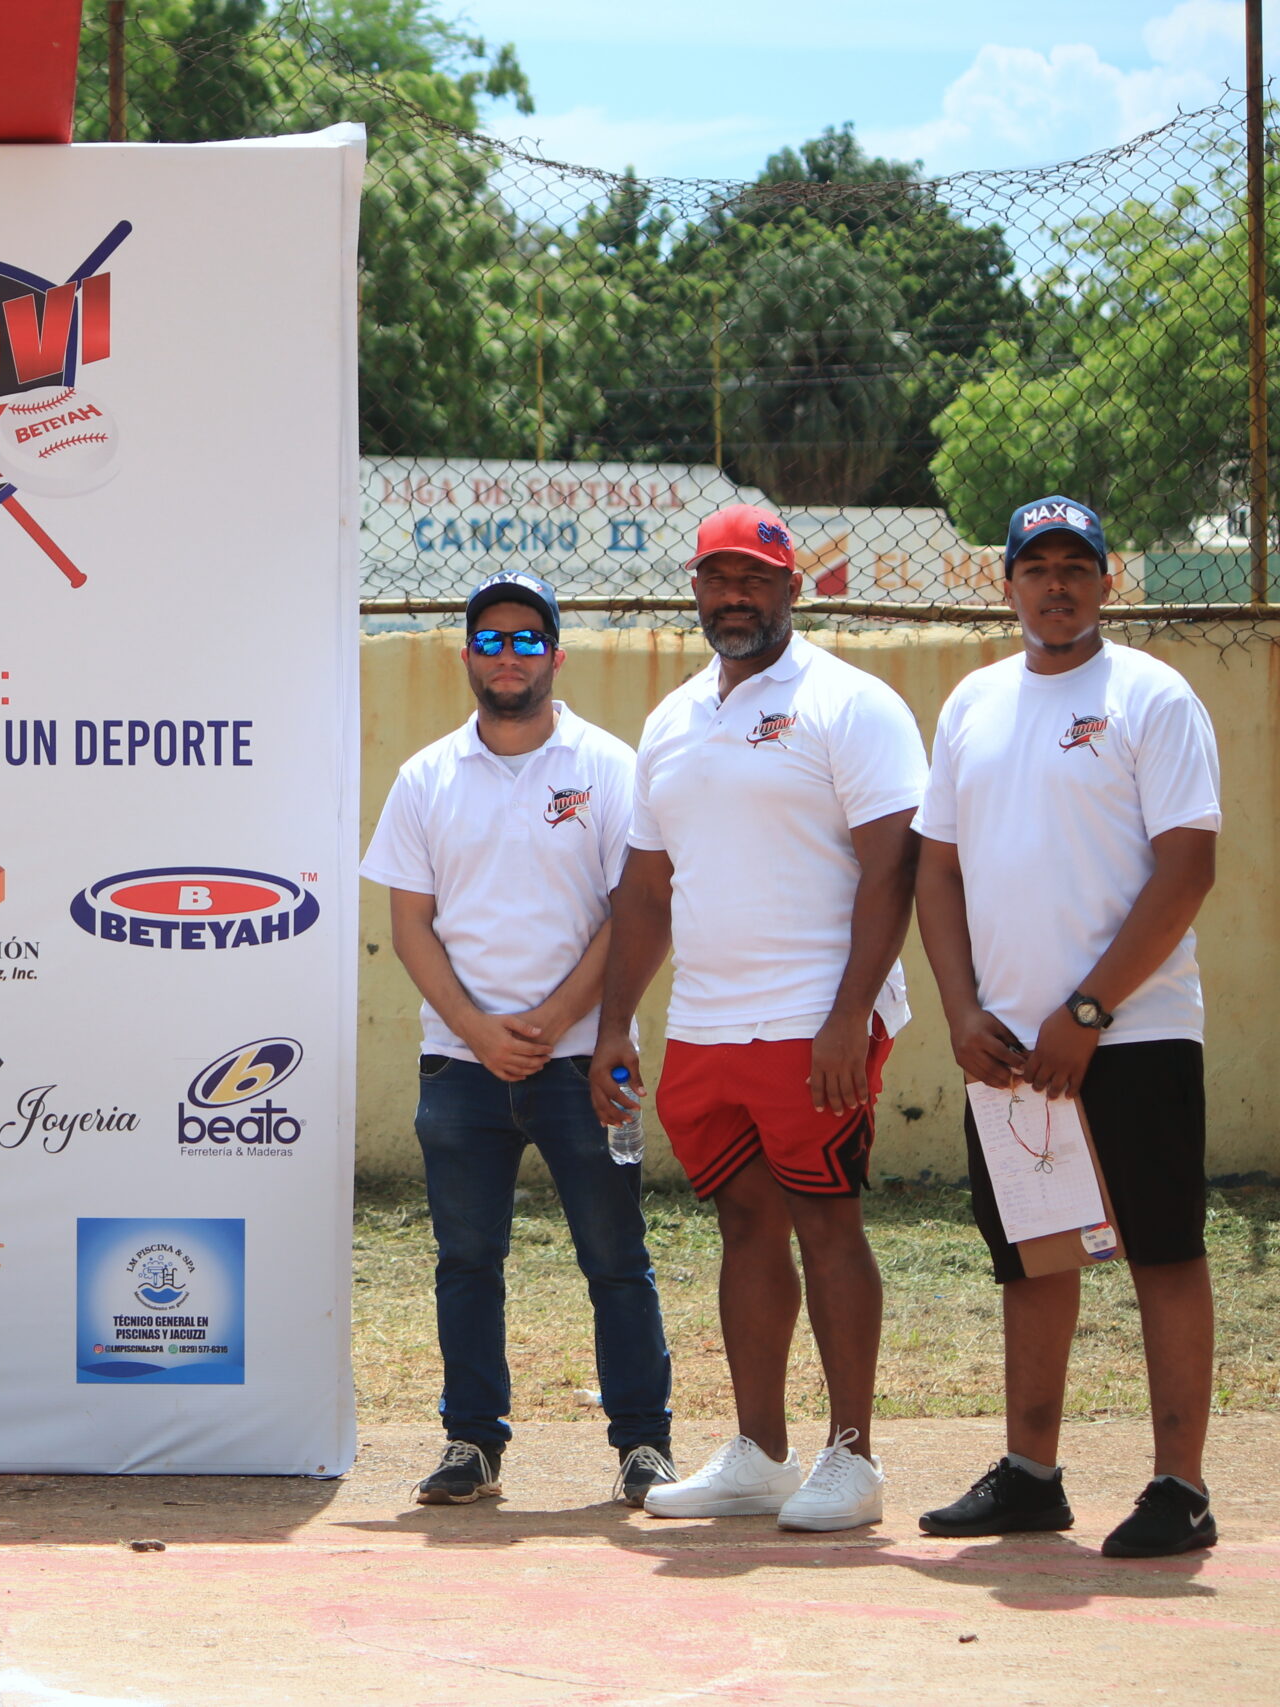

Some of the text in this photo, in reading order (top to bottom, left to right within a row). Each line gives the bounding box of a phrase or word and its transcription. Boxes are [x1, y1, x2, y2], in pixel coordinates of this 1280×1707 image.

[14, 403, 103, 445] BETEYAH
[381, 477, 457, 505] LIGA
[472, 477, 509, 506] DE
[1023, 503, 1068, 526] MAX
[415, 516, 579, 552] CANCINO
[873, 552, 924, 588] EL
[5, 719, 57, 766] UN
[75, 719, 253, 767] DEPORTE
[177, 885, 214, 911] B
[100, 910, 291, 950] BETEYAH
[11, 966, 39, 980] Inc.
[178, 1099, 302, 1145] beato
[180, 1146, 294, 1158] Ferretería & Maderas
[126, 1243, 196, 1274] LM PISCINA & SPA
[113, 1314, 209, 1327] TÉCNICO GENERAL EN
[116, 1328, 206, 1340] PISCINAS Y JACUZZI
